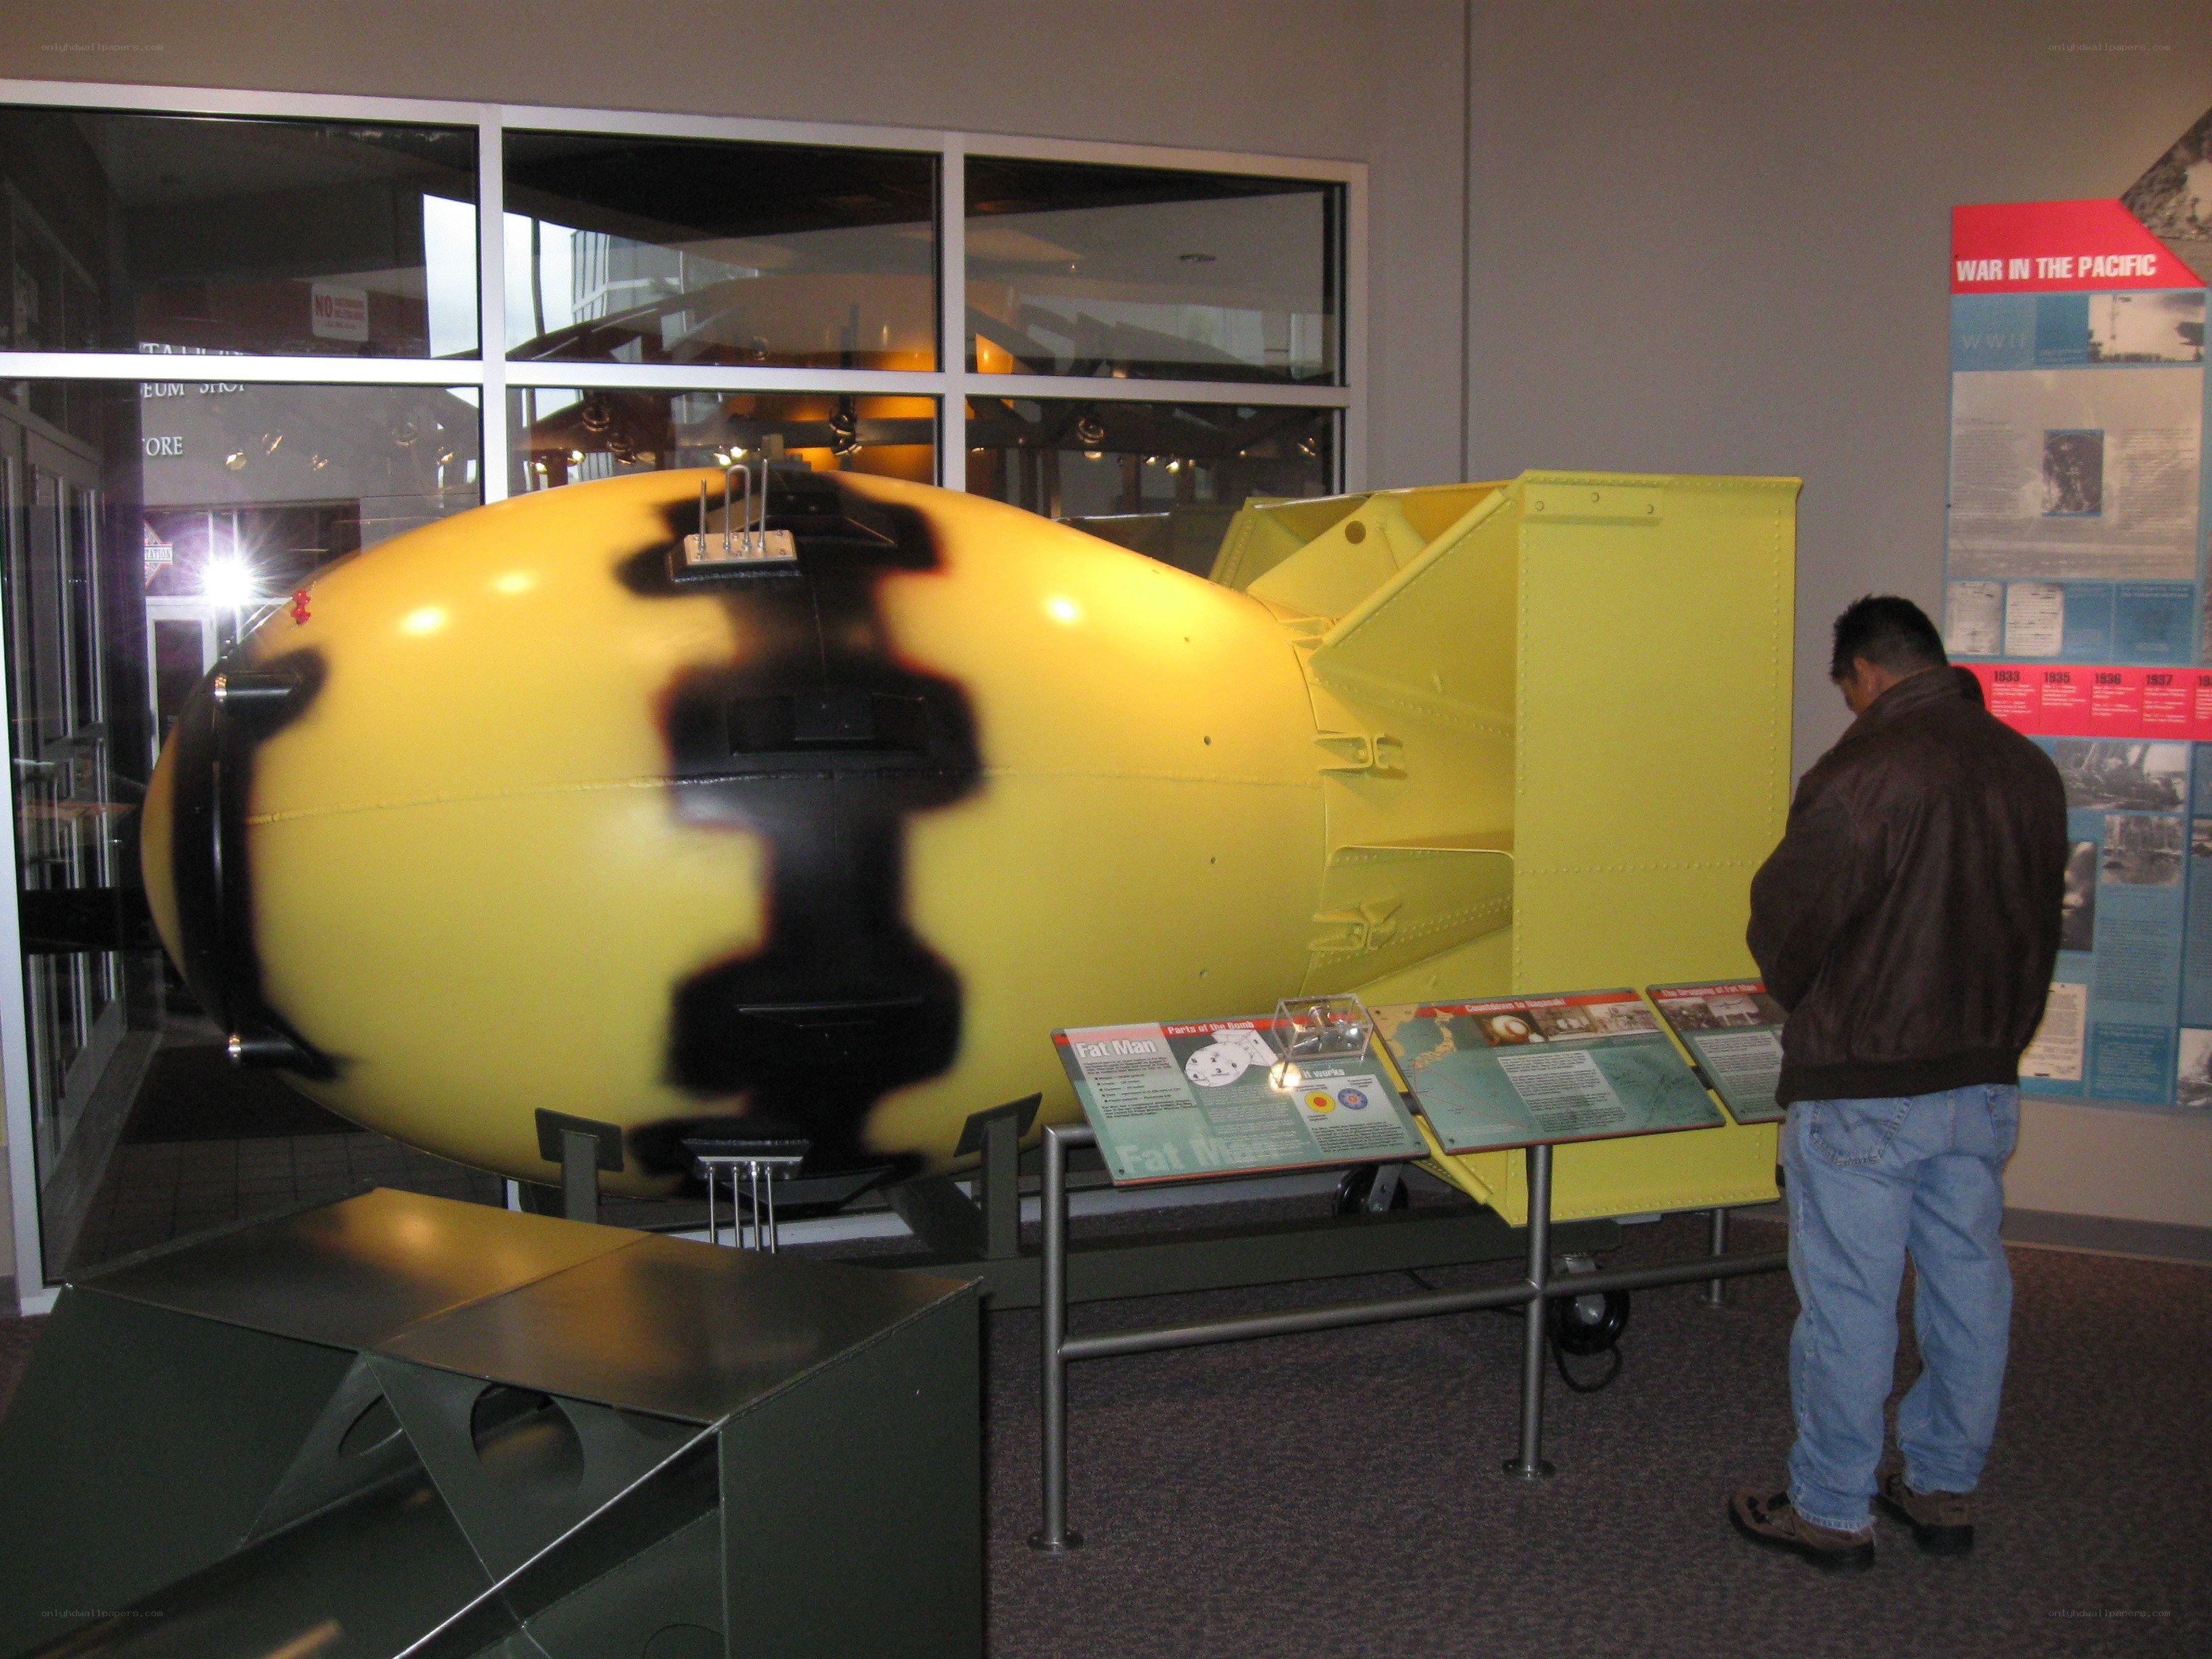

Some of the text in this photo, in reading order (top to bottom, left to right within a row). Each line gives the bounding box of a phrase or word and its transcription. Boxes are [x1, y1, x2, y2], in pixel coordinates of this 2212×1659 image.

[1956, 253, 2158, 281] WAR IN THE PACIFIC
[314, 295, 333, 316] NO
[140, 382, 186, 398] EUM
[142, 436, 184, 456] ORE
[2044, 671, 2071, 683] 1935
[2146, 674, 2173, 686] 1937
[1167, 1025, 1196, 1035] Parts
[1198, 1023, 1207, 1032] of
[1209, 1023, 1226, 1031] the
[1075, 1038, 1158, 1059] Fat Man
[1313, 1067, 1345, 1077] works
